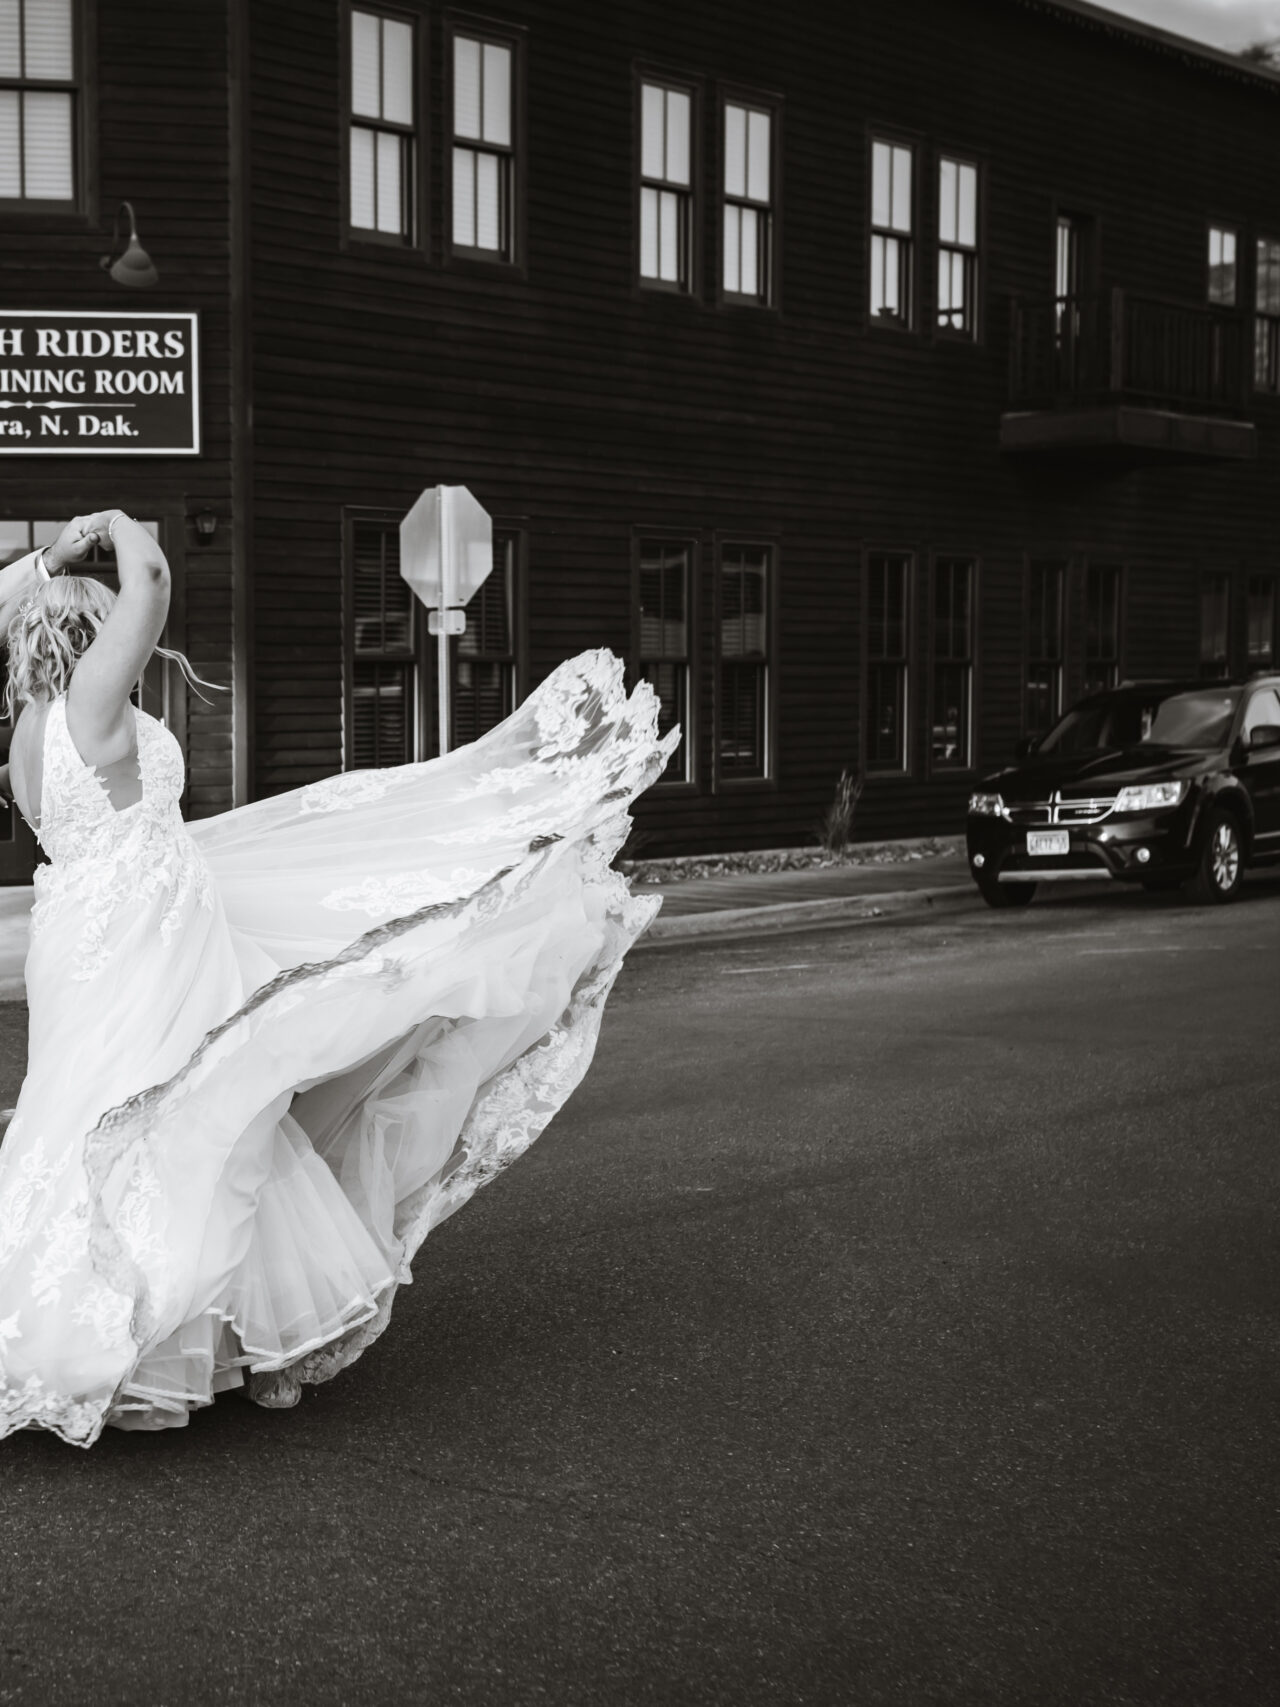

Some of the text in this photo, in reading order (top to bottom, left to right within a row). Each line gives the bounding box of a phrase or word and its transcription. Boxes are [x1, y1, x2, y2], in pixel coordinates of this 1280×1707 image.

[36, 328, 185, 359] RIDERS
[94, 369, 185, 395] ROOM
[40, 414, 70, 436] N.
[78, 414, 140, 437] Dak.
